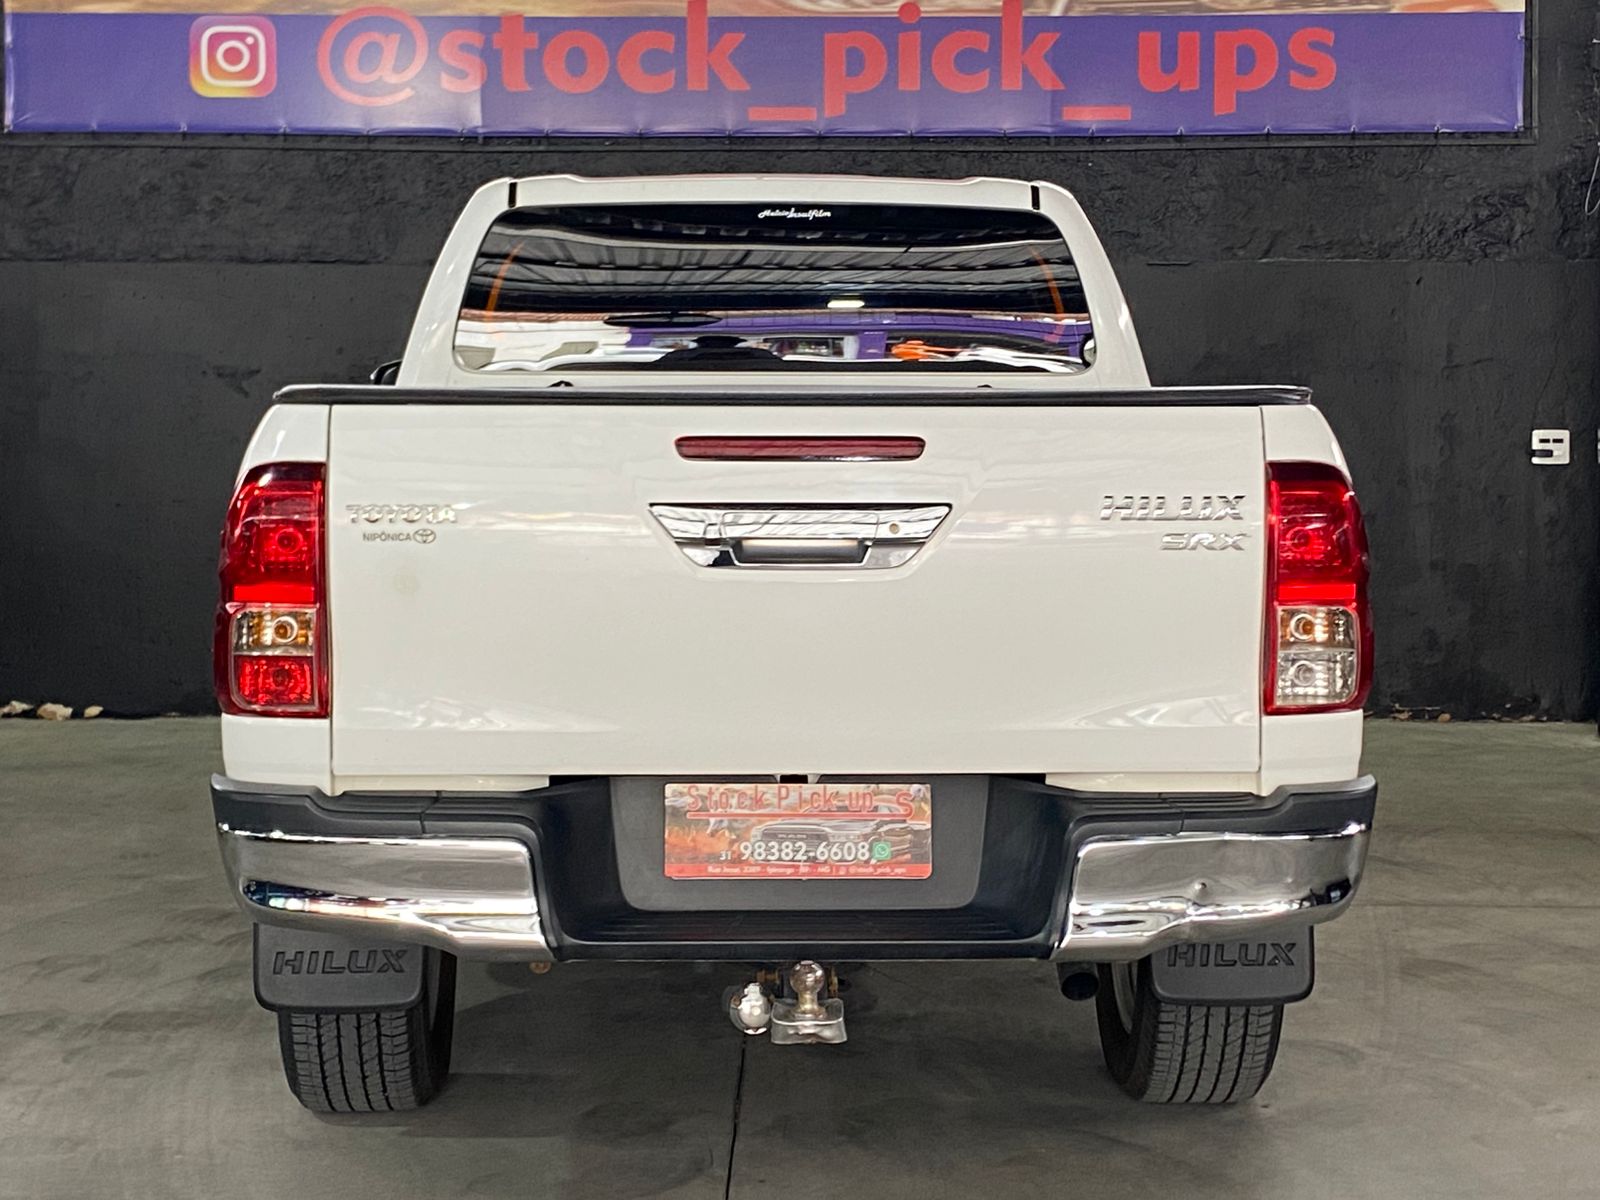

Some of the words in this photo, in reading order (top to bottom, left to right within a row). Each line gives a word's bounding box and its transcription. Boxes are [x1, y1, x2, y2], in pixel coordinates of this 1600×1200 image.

[346, 504, 457, 523] TOYOTA
[1100, 495, 1246, 521] HILUX
[363, 530, 412, 542] NIPÔNICA
[1161, 533, 1247, 551] SRX
[687, 784, 767, 810] Stock
[777, 784, 835, 810] Pick
[719, 851, 731, 861] 31
[739, 841, 870, 861] 98382-6608
[272, 949, 408, 975] HILUX
[1167, 942, 1297, 968] HILUX
